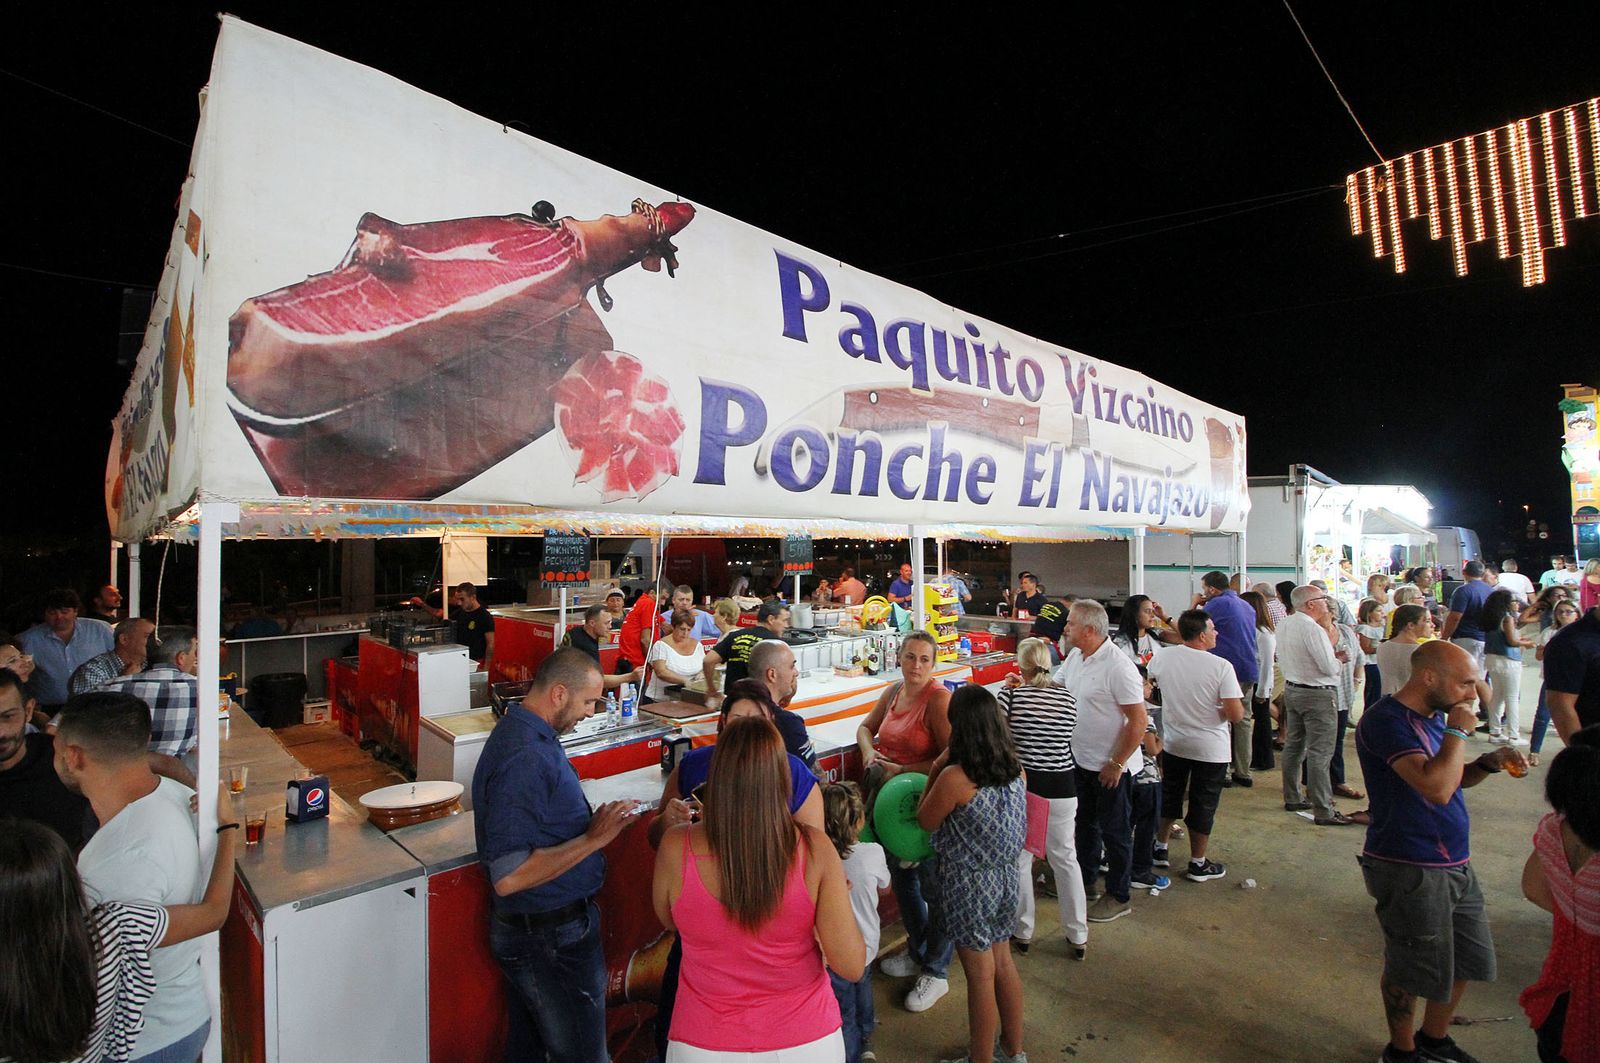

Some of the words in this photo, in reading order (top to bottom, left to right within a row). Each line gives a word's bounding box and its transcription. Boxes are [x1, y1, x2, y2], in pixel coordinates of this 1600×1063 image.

[773, 248, 1045, 402] Paquito
[1056, 352, 1194, 443] Vizcaino
[692, 376, 997, 505] Ponche
[1017, 436, 1065, 509] El
[1079, 447, 1212, 526] Navajazo
